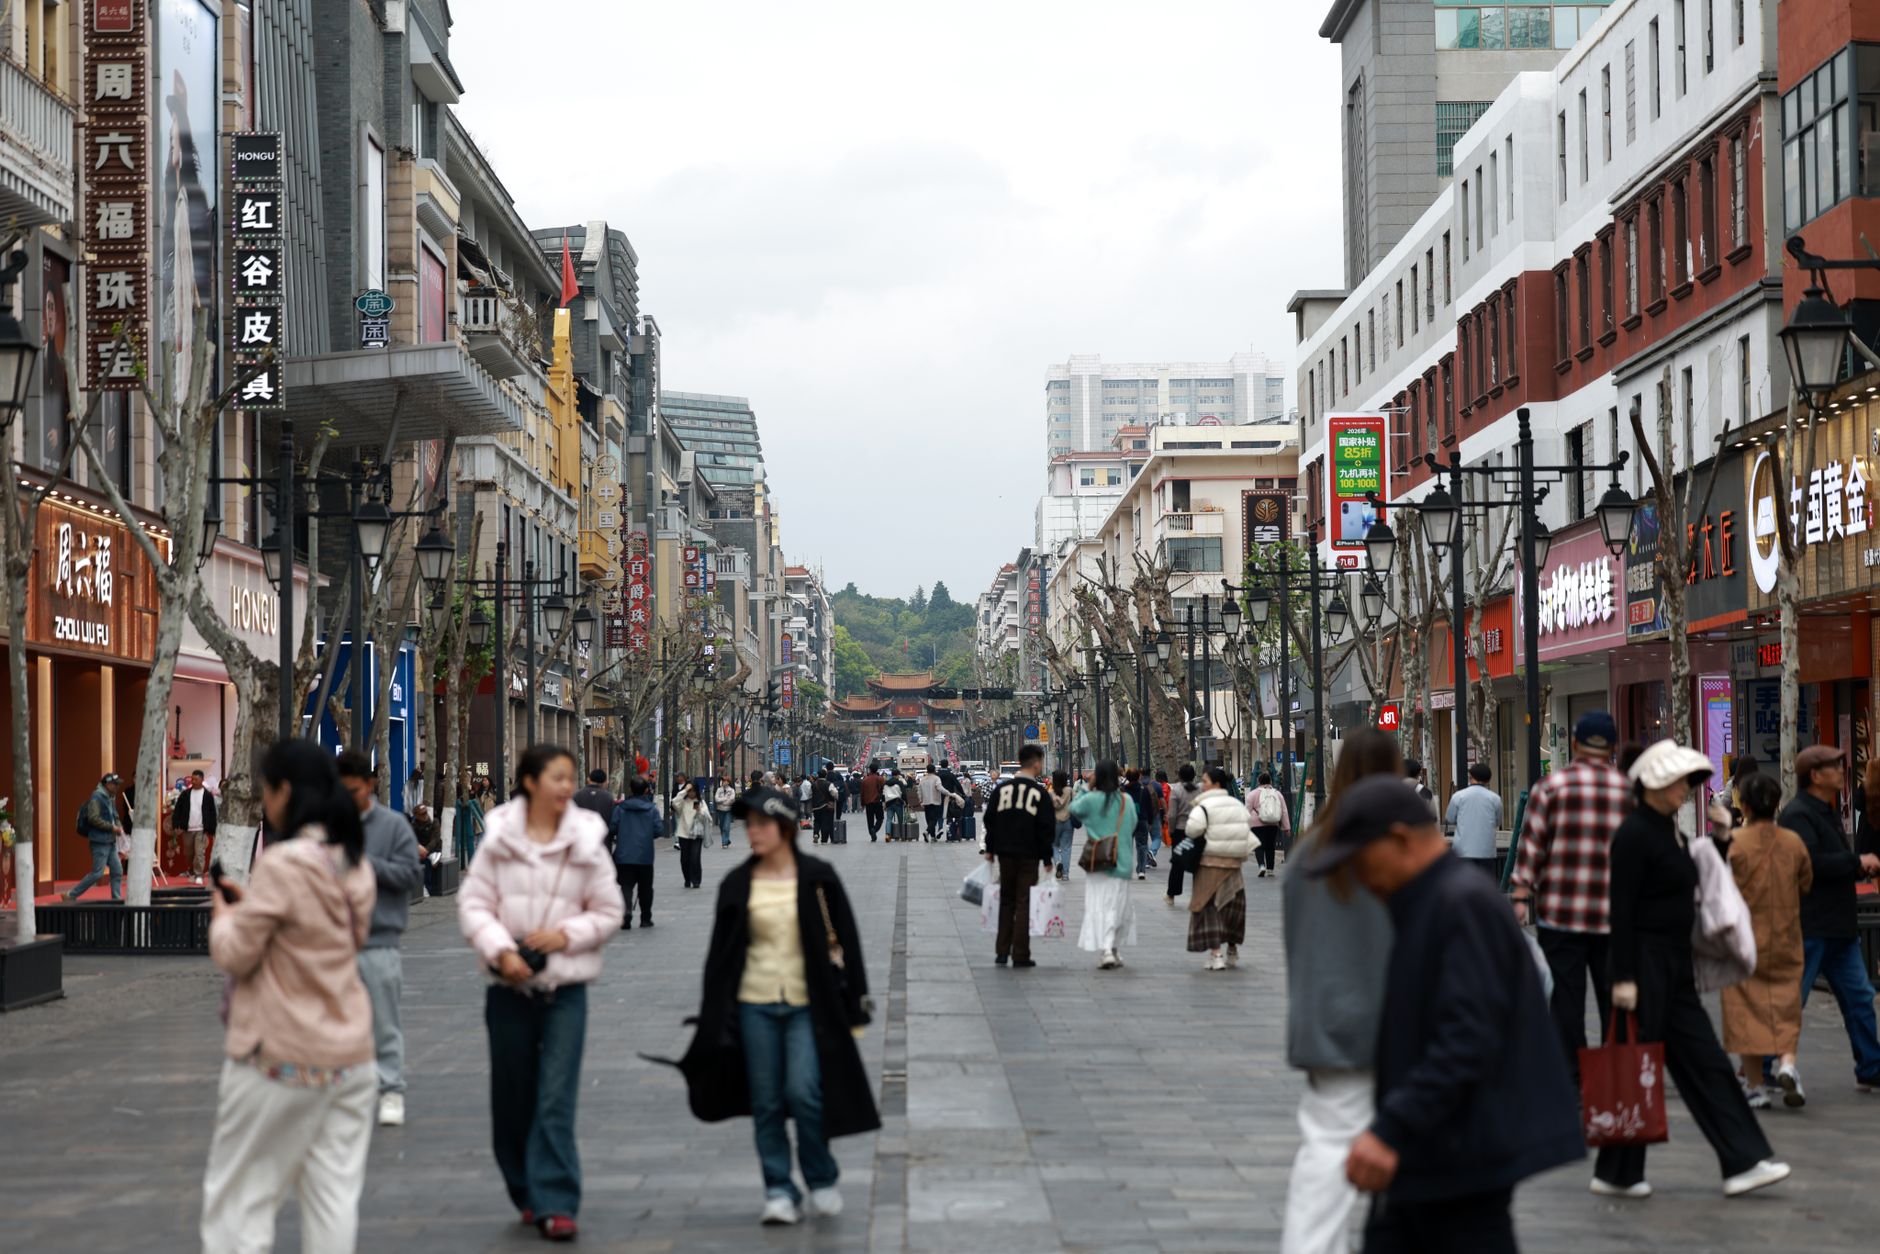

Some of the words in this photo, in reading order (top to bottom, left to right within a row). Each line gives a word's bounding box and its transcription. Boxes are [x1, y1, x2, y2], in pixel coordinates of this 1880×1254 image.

[237, 151, 275, 161] HONGU
[241, 199, 274, 401] 红谷皮具
[1339, 437, 1376, 447] 国家补贴
[1340, 468, 1378, 478] 九机再补
[55, 522, 113, 608] 周六福
[1340, 557, 1356, 566] 九机
[231, 585, 277, 637] HONGU
[55, 616, 80, 642] ZHOU
[81, 621, 95, 644] LIU
[97, 624, 109, 646] FU
